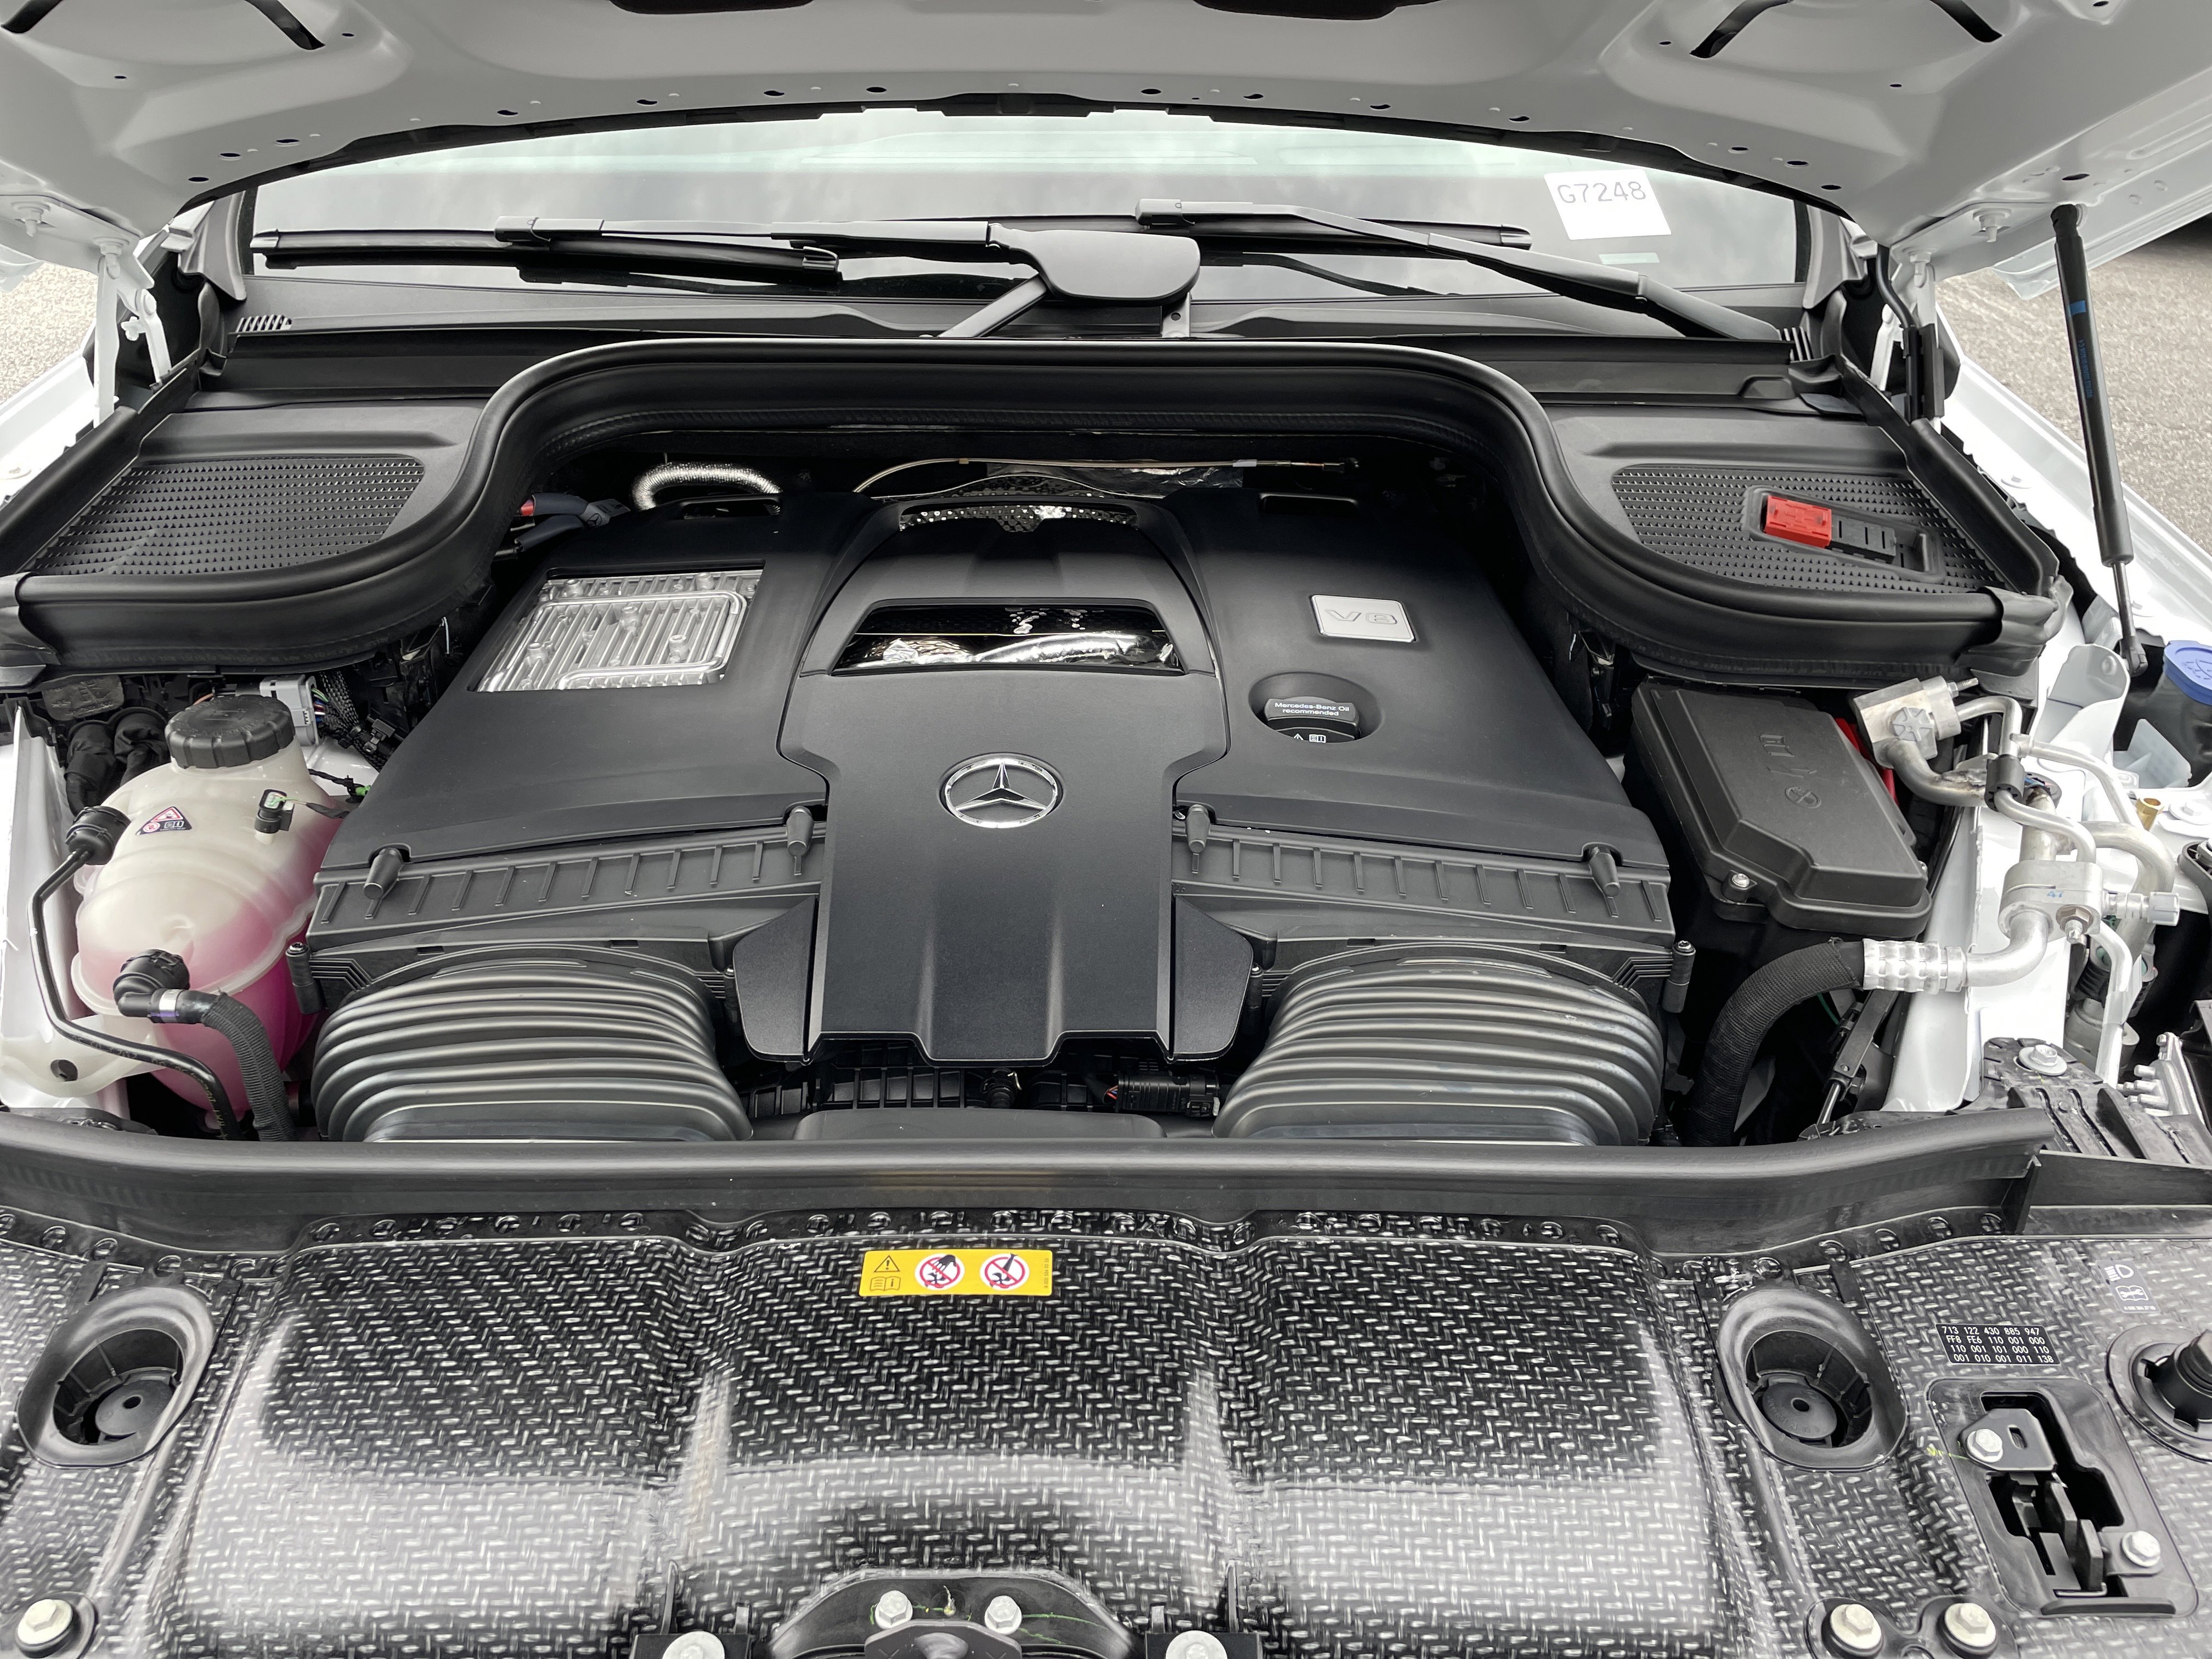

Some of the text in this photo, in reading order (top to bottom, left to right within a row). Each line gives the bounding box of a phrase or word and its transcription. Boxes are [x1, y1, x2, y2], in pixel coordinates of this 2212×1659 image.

[1557, 181, 1646, 204] G7248
[1324, 609, 1398, 624] V8
[1274, 702, 1336, 711] Mercedes-Benz
[1963, 1327, 1979, 1335] 122
[1946, 1335, 1961, 1343] FF8
